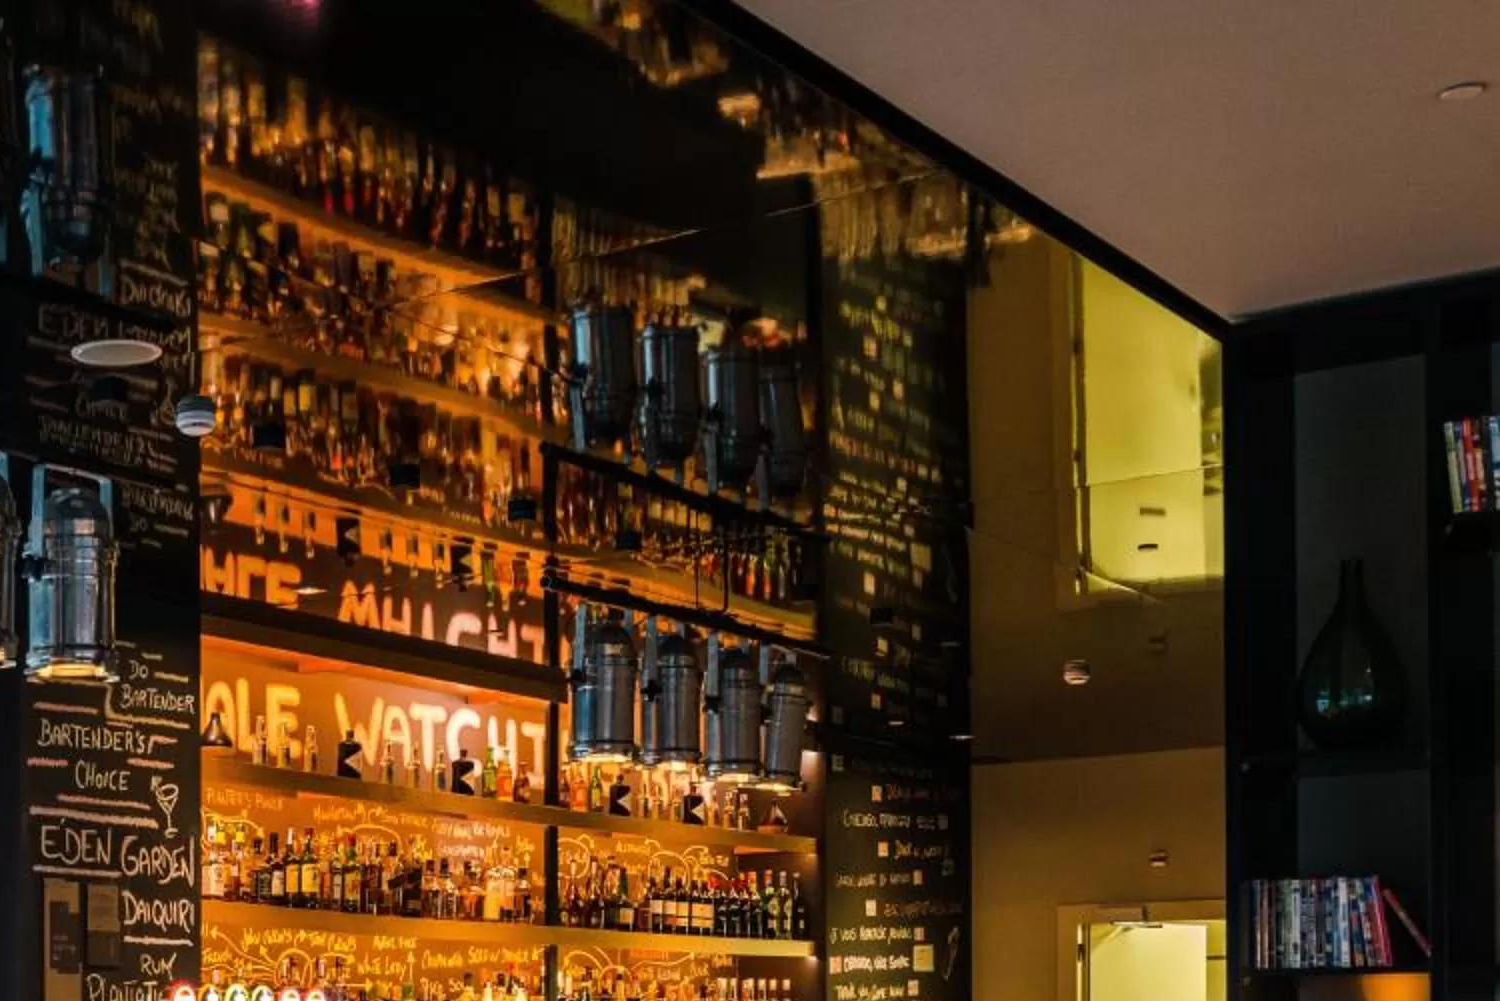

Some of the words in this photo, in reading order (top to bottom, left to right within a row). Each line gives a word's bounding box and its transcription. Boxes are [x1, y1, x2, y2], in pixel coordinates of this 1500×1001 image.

[119, 683, 196, 714] BARTENDER
[200, 677, 303, 760] ALE
[74, 759, 131, 791] CHOICE
[120, 834, 196, 888] GARDEN
[121, 889, 195, 931] DAIQUIRI
